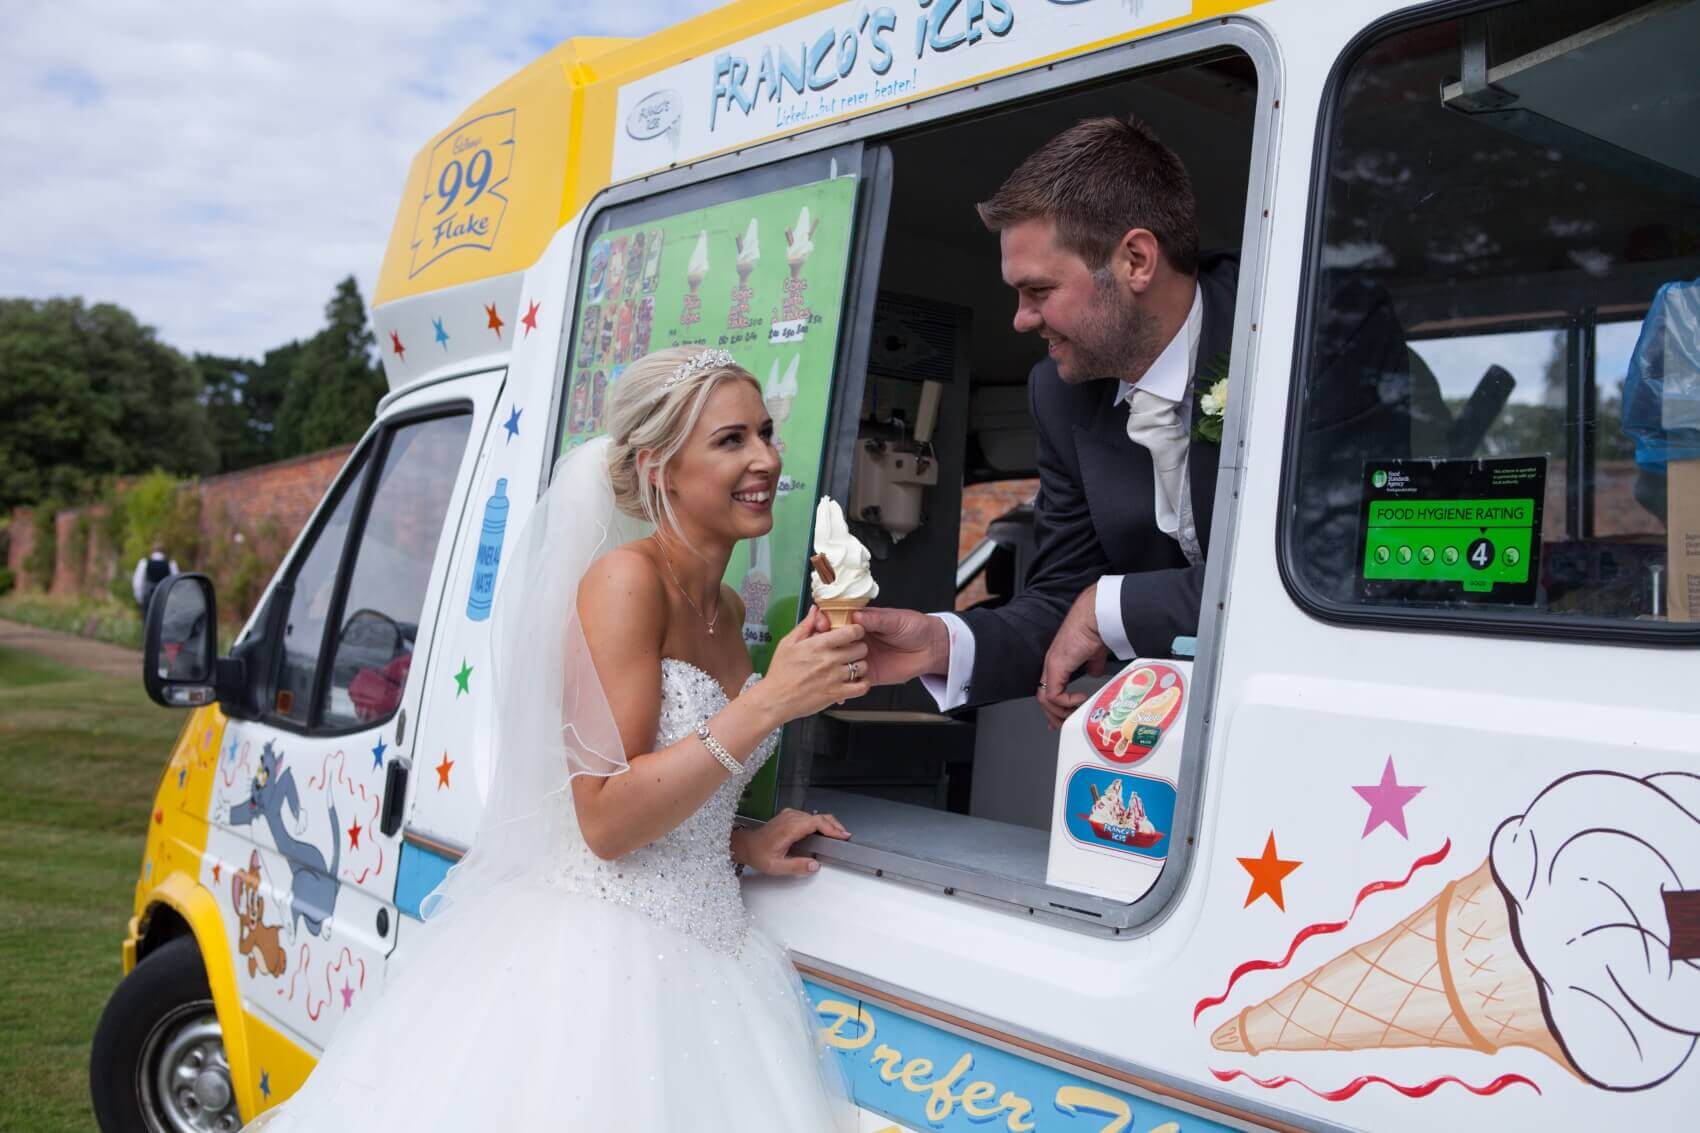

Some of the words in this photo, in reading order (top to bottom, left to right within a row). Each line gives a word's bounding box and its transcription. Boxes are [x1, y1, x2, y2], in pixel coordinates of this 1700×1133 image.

[711, 6, 896, 132] FRANCO'S
[436, 149, 492, 215] 99
[432, 212, 488, 249] Flake
[1377, 508, 1414, 520] FOOD
[1418, 508, 1472, 520] HYGIENE
[1476, 507, 1524, 520] RATING
[1471, 543, 1488, 567] 4
